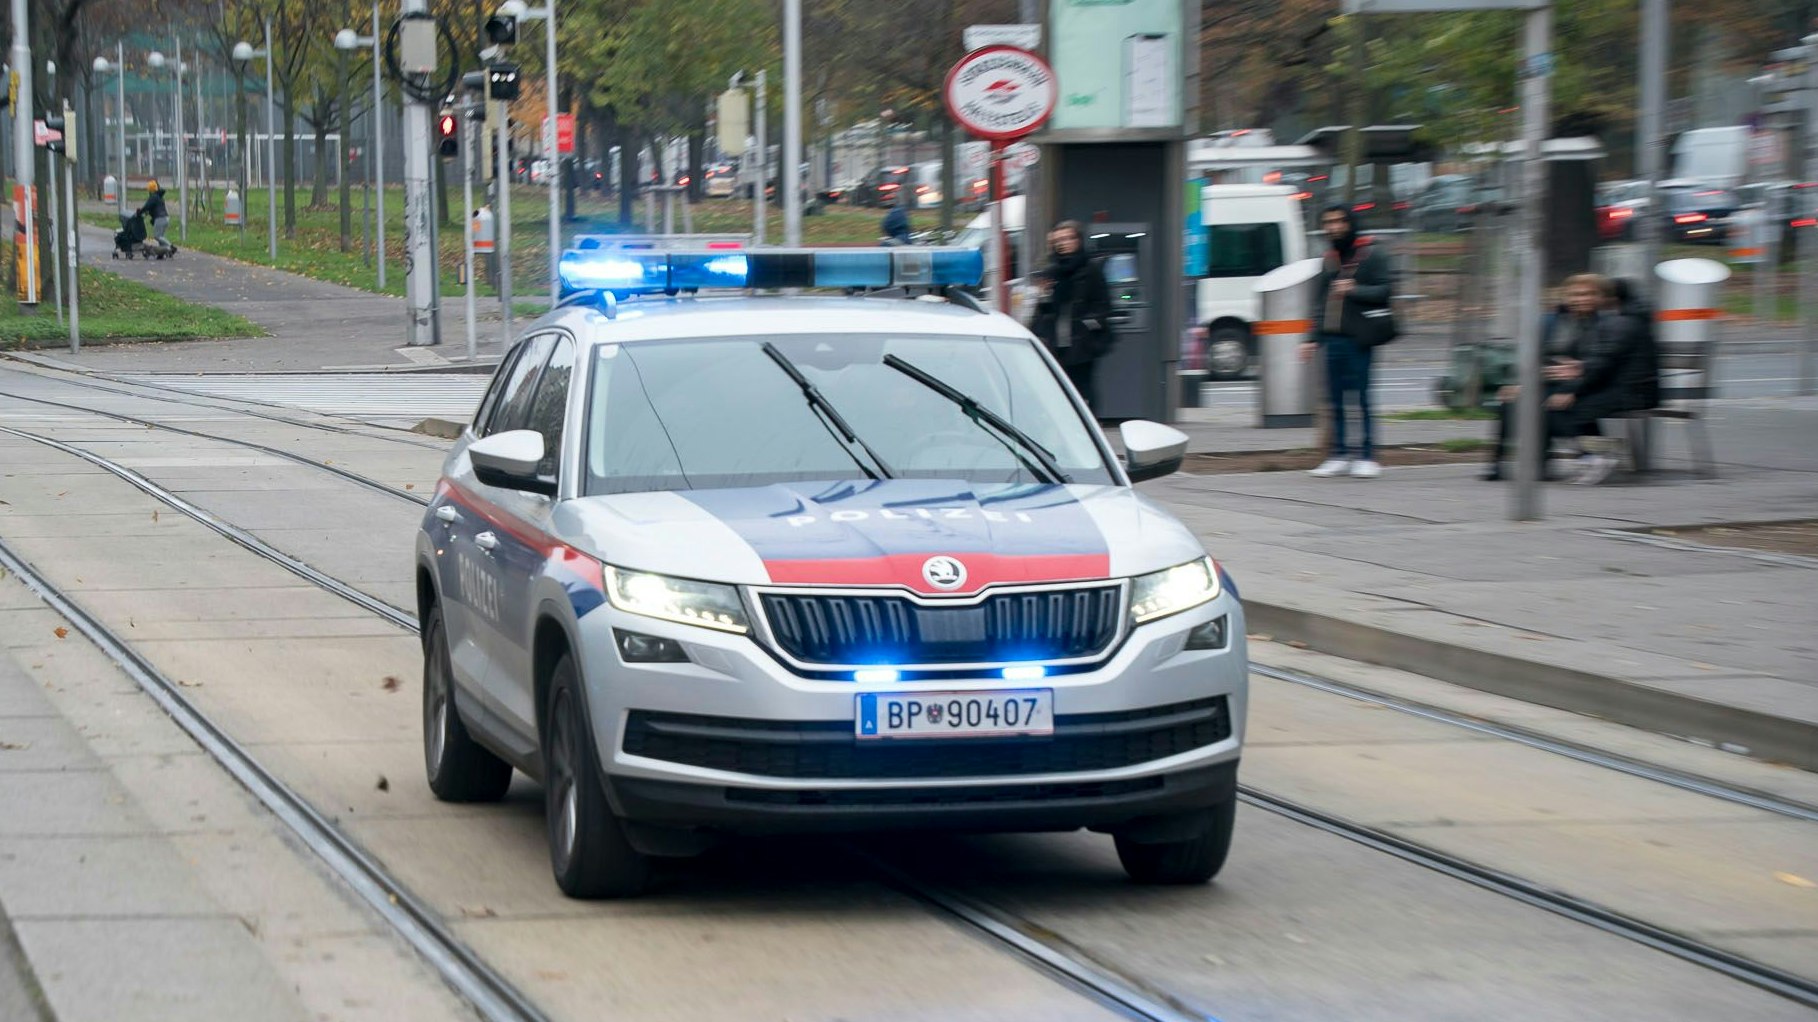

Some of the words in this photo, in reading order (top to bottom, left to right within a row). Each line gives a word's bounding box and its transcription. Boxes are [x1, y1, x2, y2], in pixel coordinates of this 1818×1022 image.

[787, 508, 1032, 527] POLIZEI
[458, 552, 499, 622] POLIZEI
[888, 701, 922, 729] BP
[947, 698, 1038, 728] 90407
